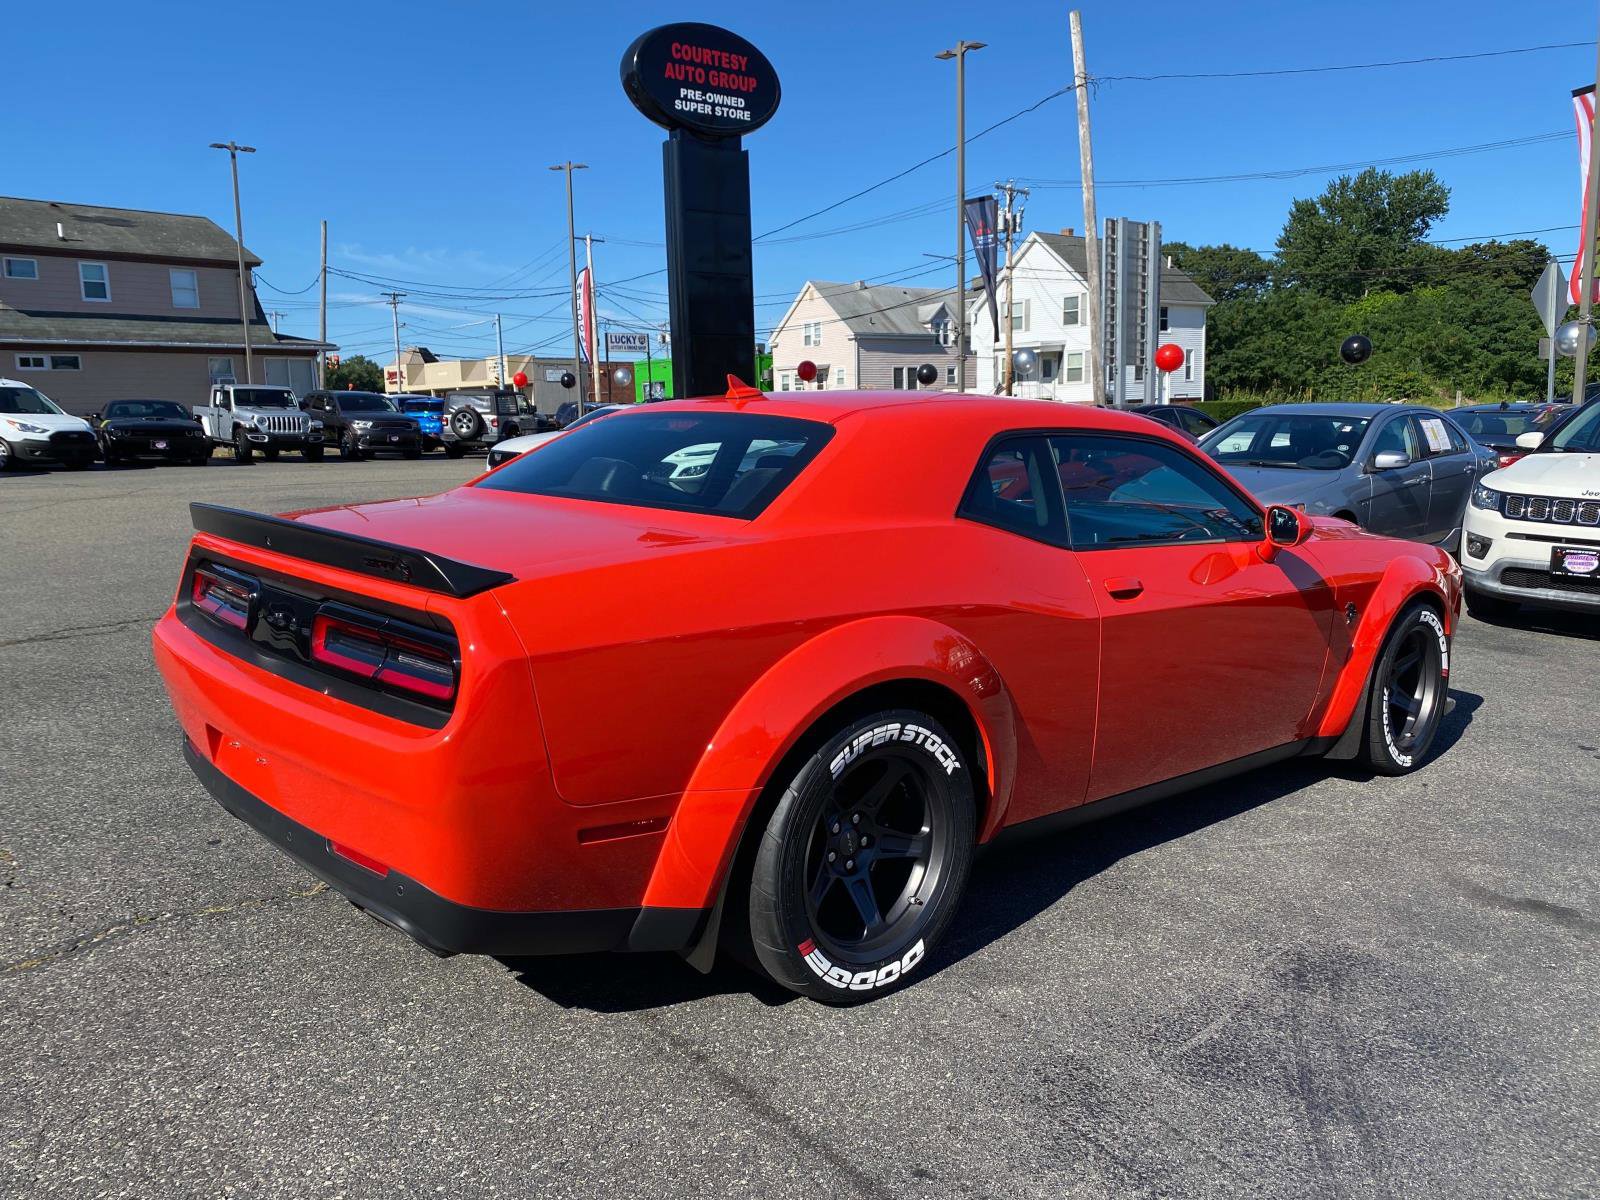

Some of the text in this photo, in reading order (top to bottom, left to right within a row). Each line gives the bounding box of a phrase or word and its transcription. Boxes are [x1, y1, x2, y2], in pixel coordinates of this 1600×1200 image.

[671, 42, 749, 71] COURTESY
[664, 62, 757, 93] AUTO GROUP
[674, 99, 751, 121] SUPER STORE
[680, 88, 746, 108] PRE-OWNED
[610, 334, 637, 345] LUCKY
[1581, 489, 1600, 498] Jee
[1419, 611, 1449, 669] DODGE
[1383, 686, 1392, 745] STOCK
[830, 723, 960, 780] SUPER STOCK
[803, 939, 925, 991] DODGE
